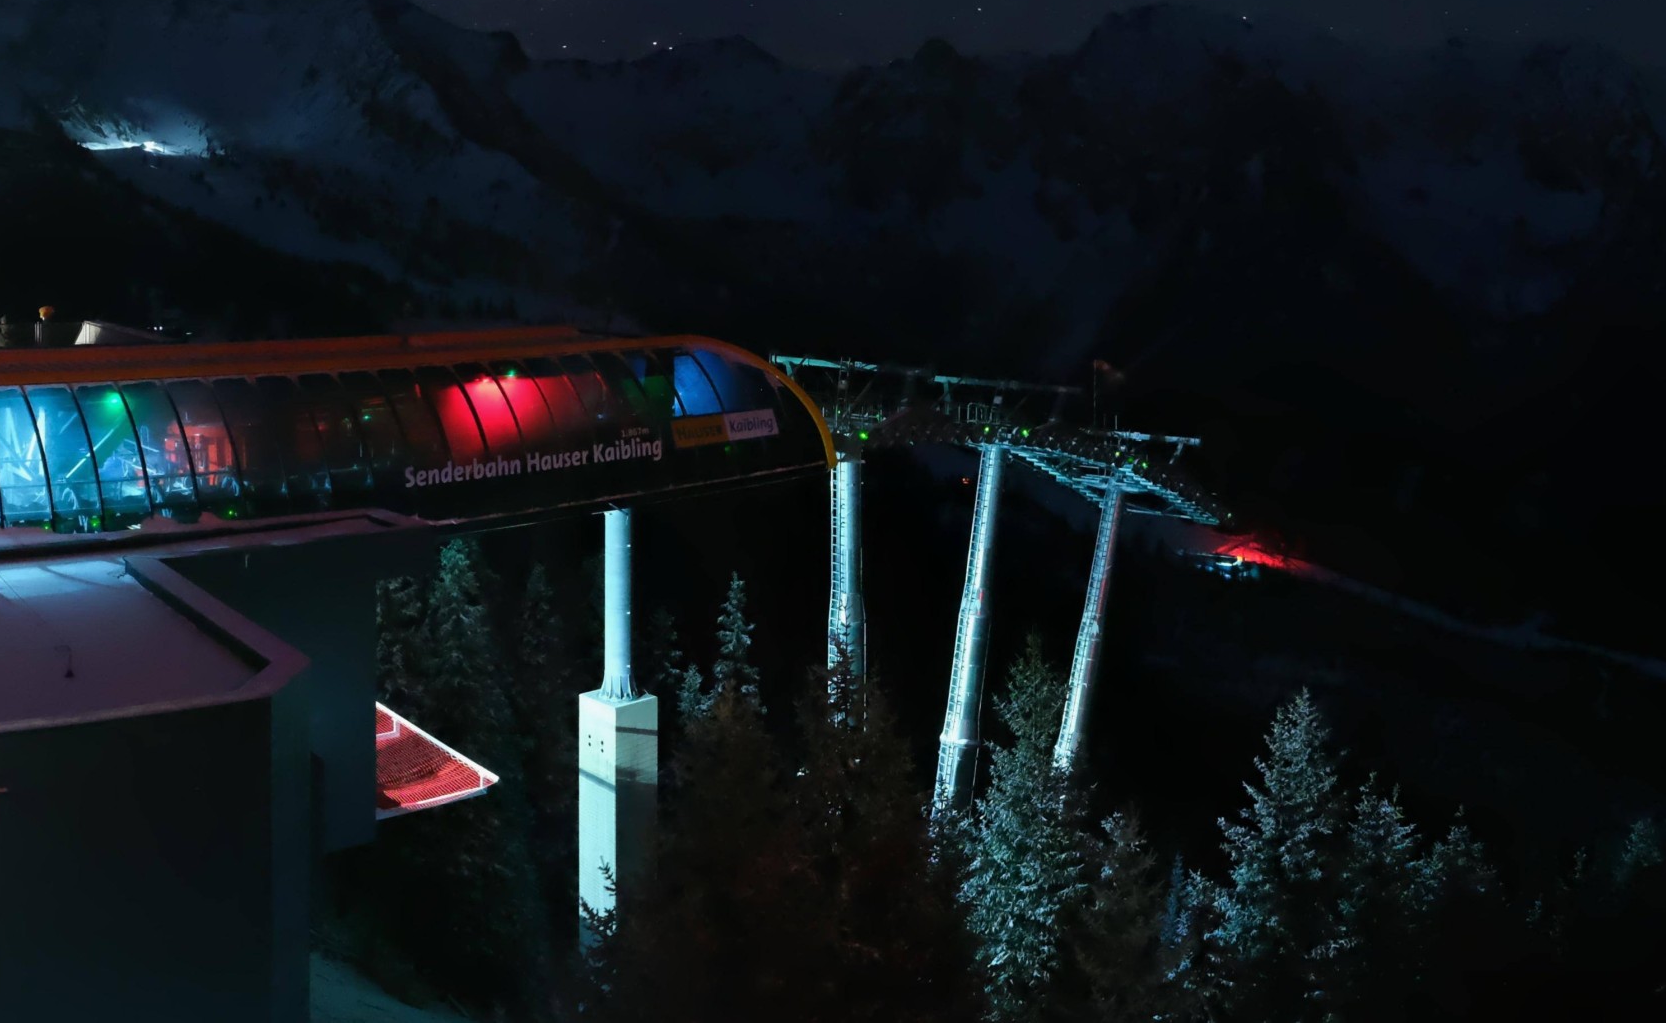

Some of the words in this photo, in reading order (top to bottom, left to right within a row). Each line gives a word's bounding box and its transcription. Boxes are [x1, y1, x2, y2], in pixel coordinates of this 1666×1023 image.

[729, 416, 774, 433] Kaibling
[404, 456, 521, 488] Senderbahn
[527, 450, 588, 473] Hauser
[593, 437, 662, 463] Kaibling
